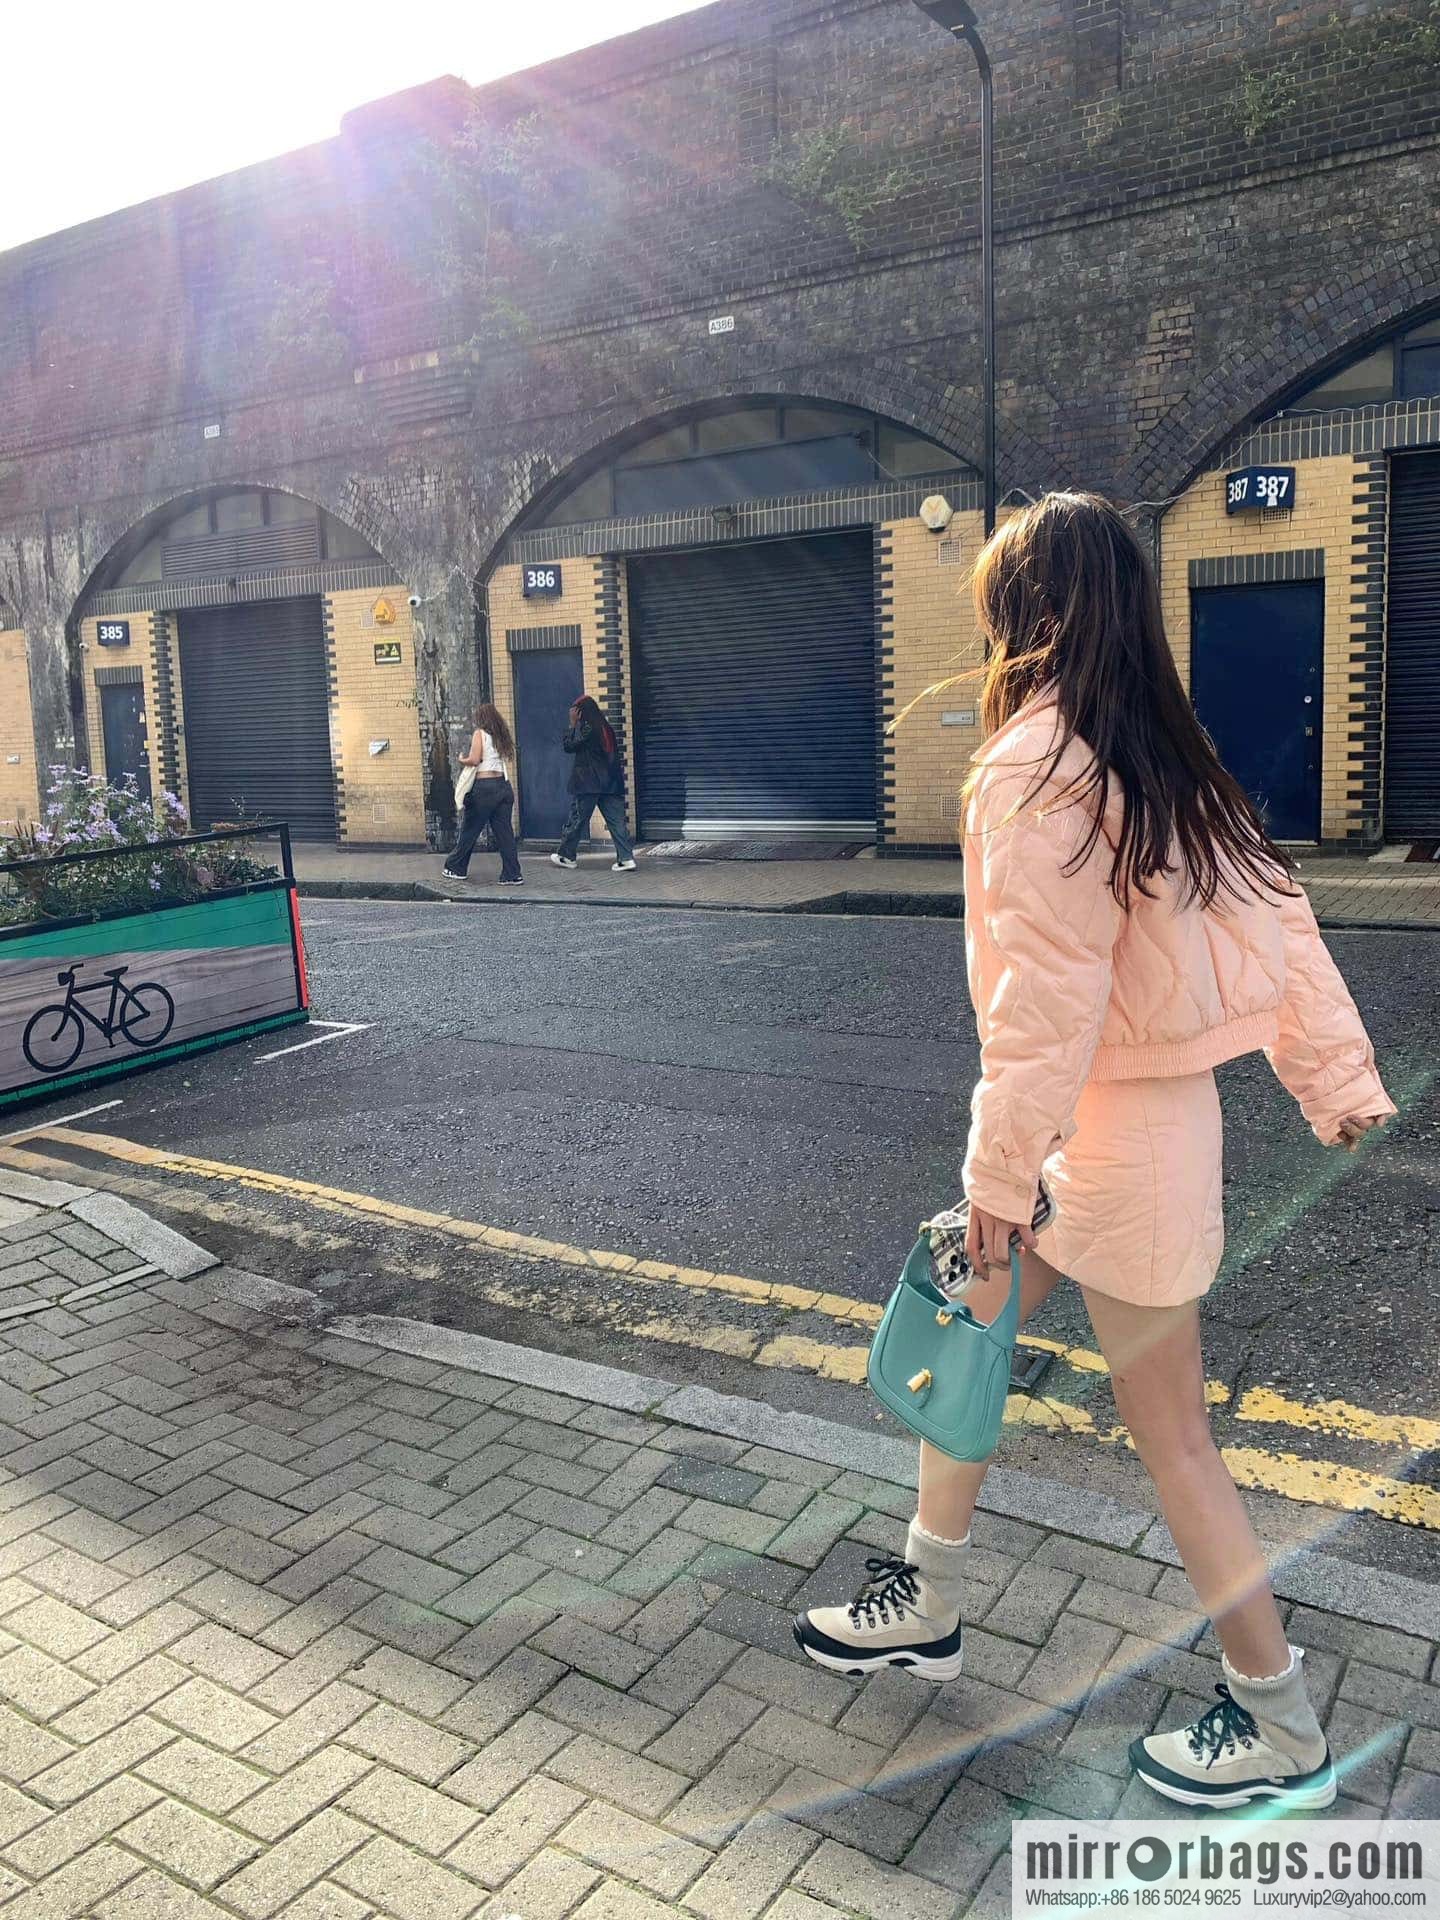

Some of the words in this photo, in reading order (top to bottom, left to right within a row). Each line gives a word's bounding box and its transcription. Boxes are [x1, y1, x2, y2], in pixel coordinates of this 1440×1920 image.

[711, 319, 732, 331] A386
[1228, 477, 1249, 504] 387
[1256, 475, 1289, 497] 387
[527, 570, 555, 588] 386
[100, 625, 123, 640] 385
